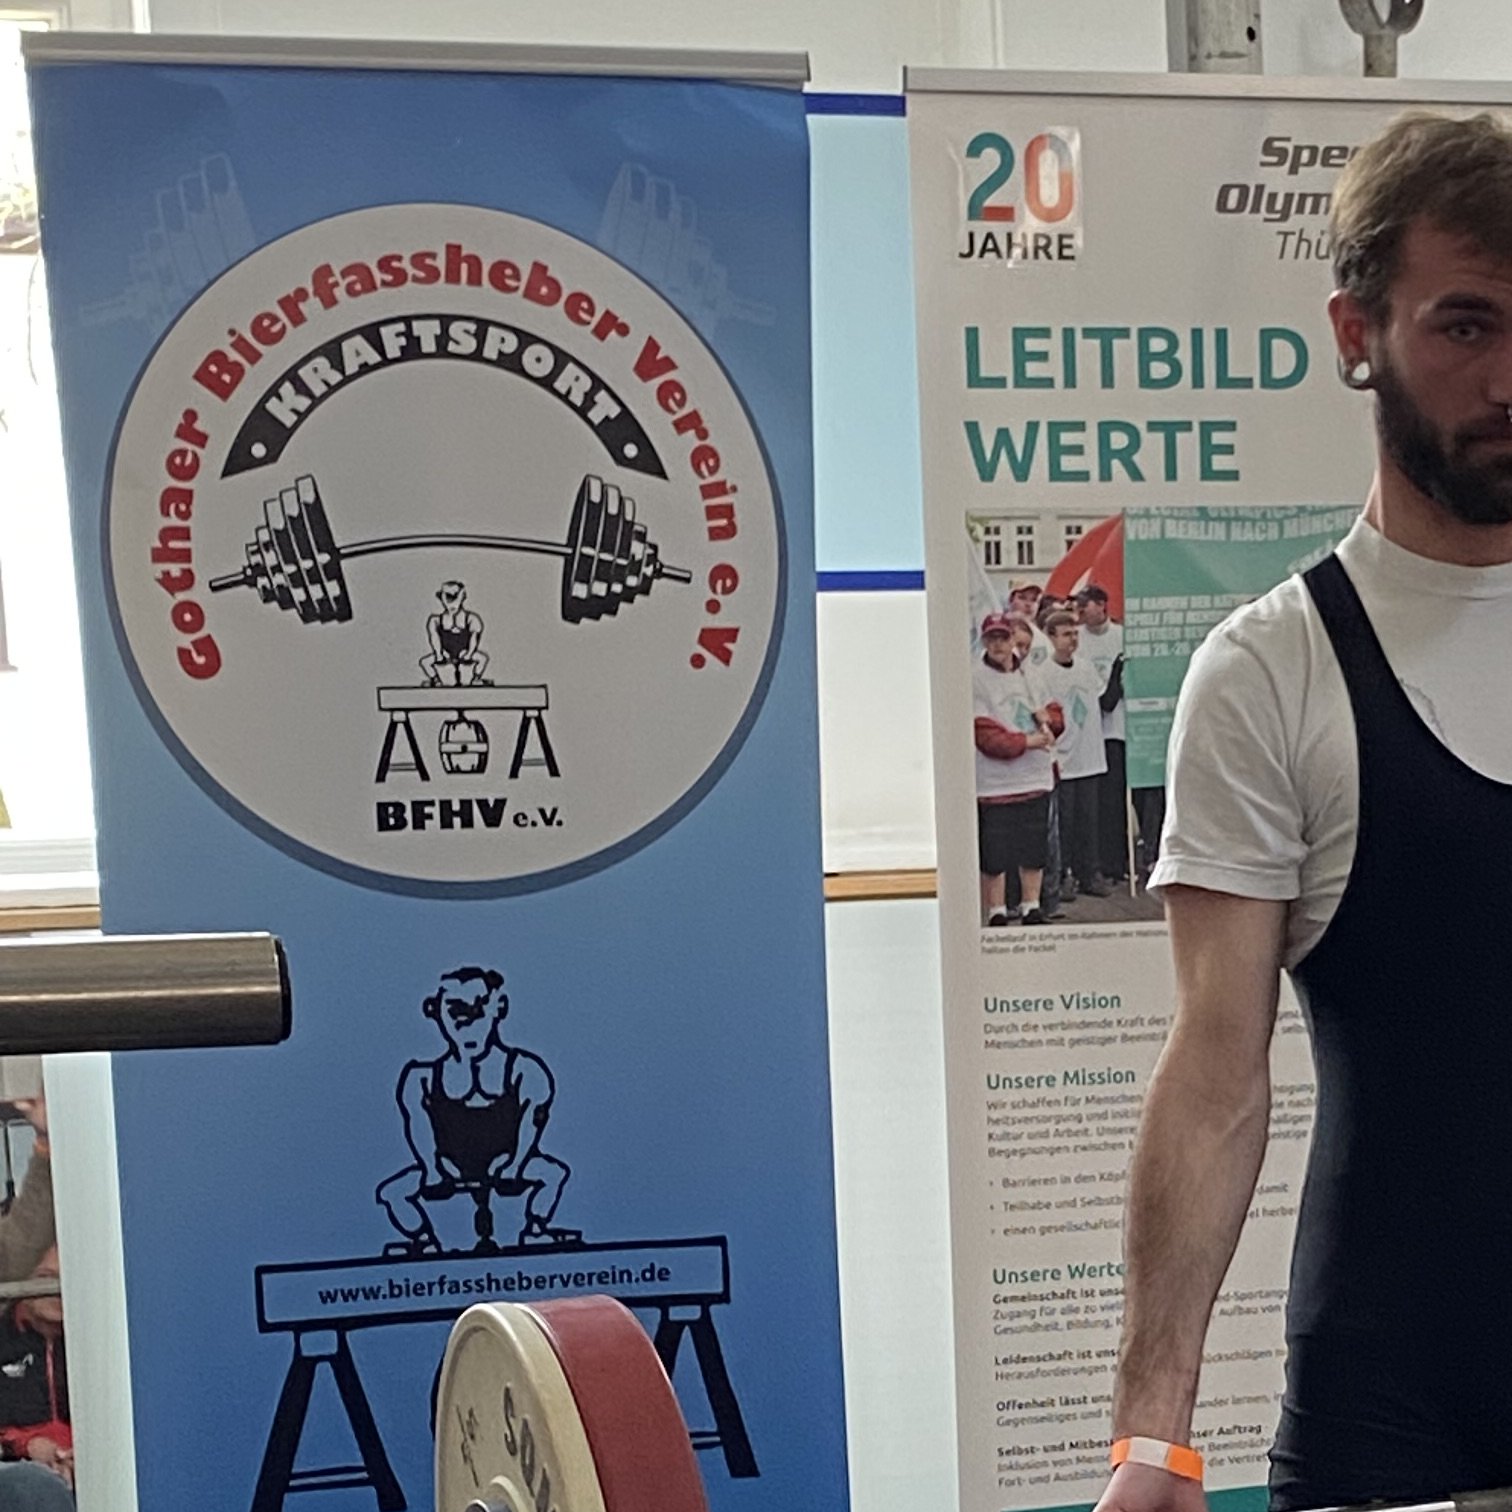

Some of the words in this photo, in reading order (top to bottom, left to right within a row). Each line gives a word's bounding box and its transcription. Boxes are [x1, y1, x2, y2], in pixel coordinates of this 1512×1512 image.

[965, 132, 1075, 223] 20
[1215, 184, 1332, 222] Olym
[958, 231, 1076, 262] JAHRE
[265, 318, 621, 429] KRAFTSPORT
[964, 326, 1309, 390] LEITBILD
[151, 409, 222, 681] Gothaer
[192, 243, 630, 401] Bierfassheber
[632, 336, 739, 542] Verein
[688, 563, 740, 671] e.V.
[964, 421, 1241, 483] WERTE
[376, 798, 508, 832] BFHV
[512, 807, 563, 829] e.V.
[984, 997, 1054, 1013] Unsere
[1060, 992, 1121, 1010] Vision
[987, 1074, 1057, 1090] Unsere
[1063, 1067, 1136, 1086] Mission
[317, 1262, 671, 1305] www.bierfassheberverein.de
[992, 1268, 1062, 1284] Unsere
